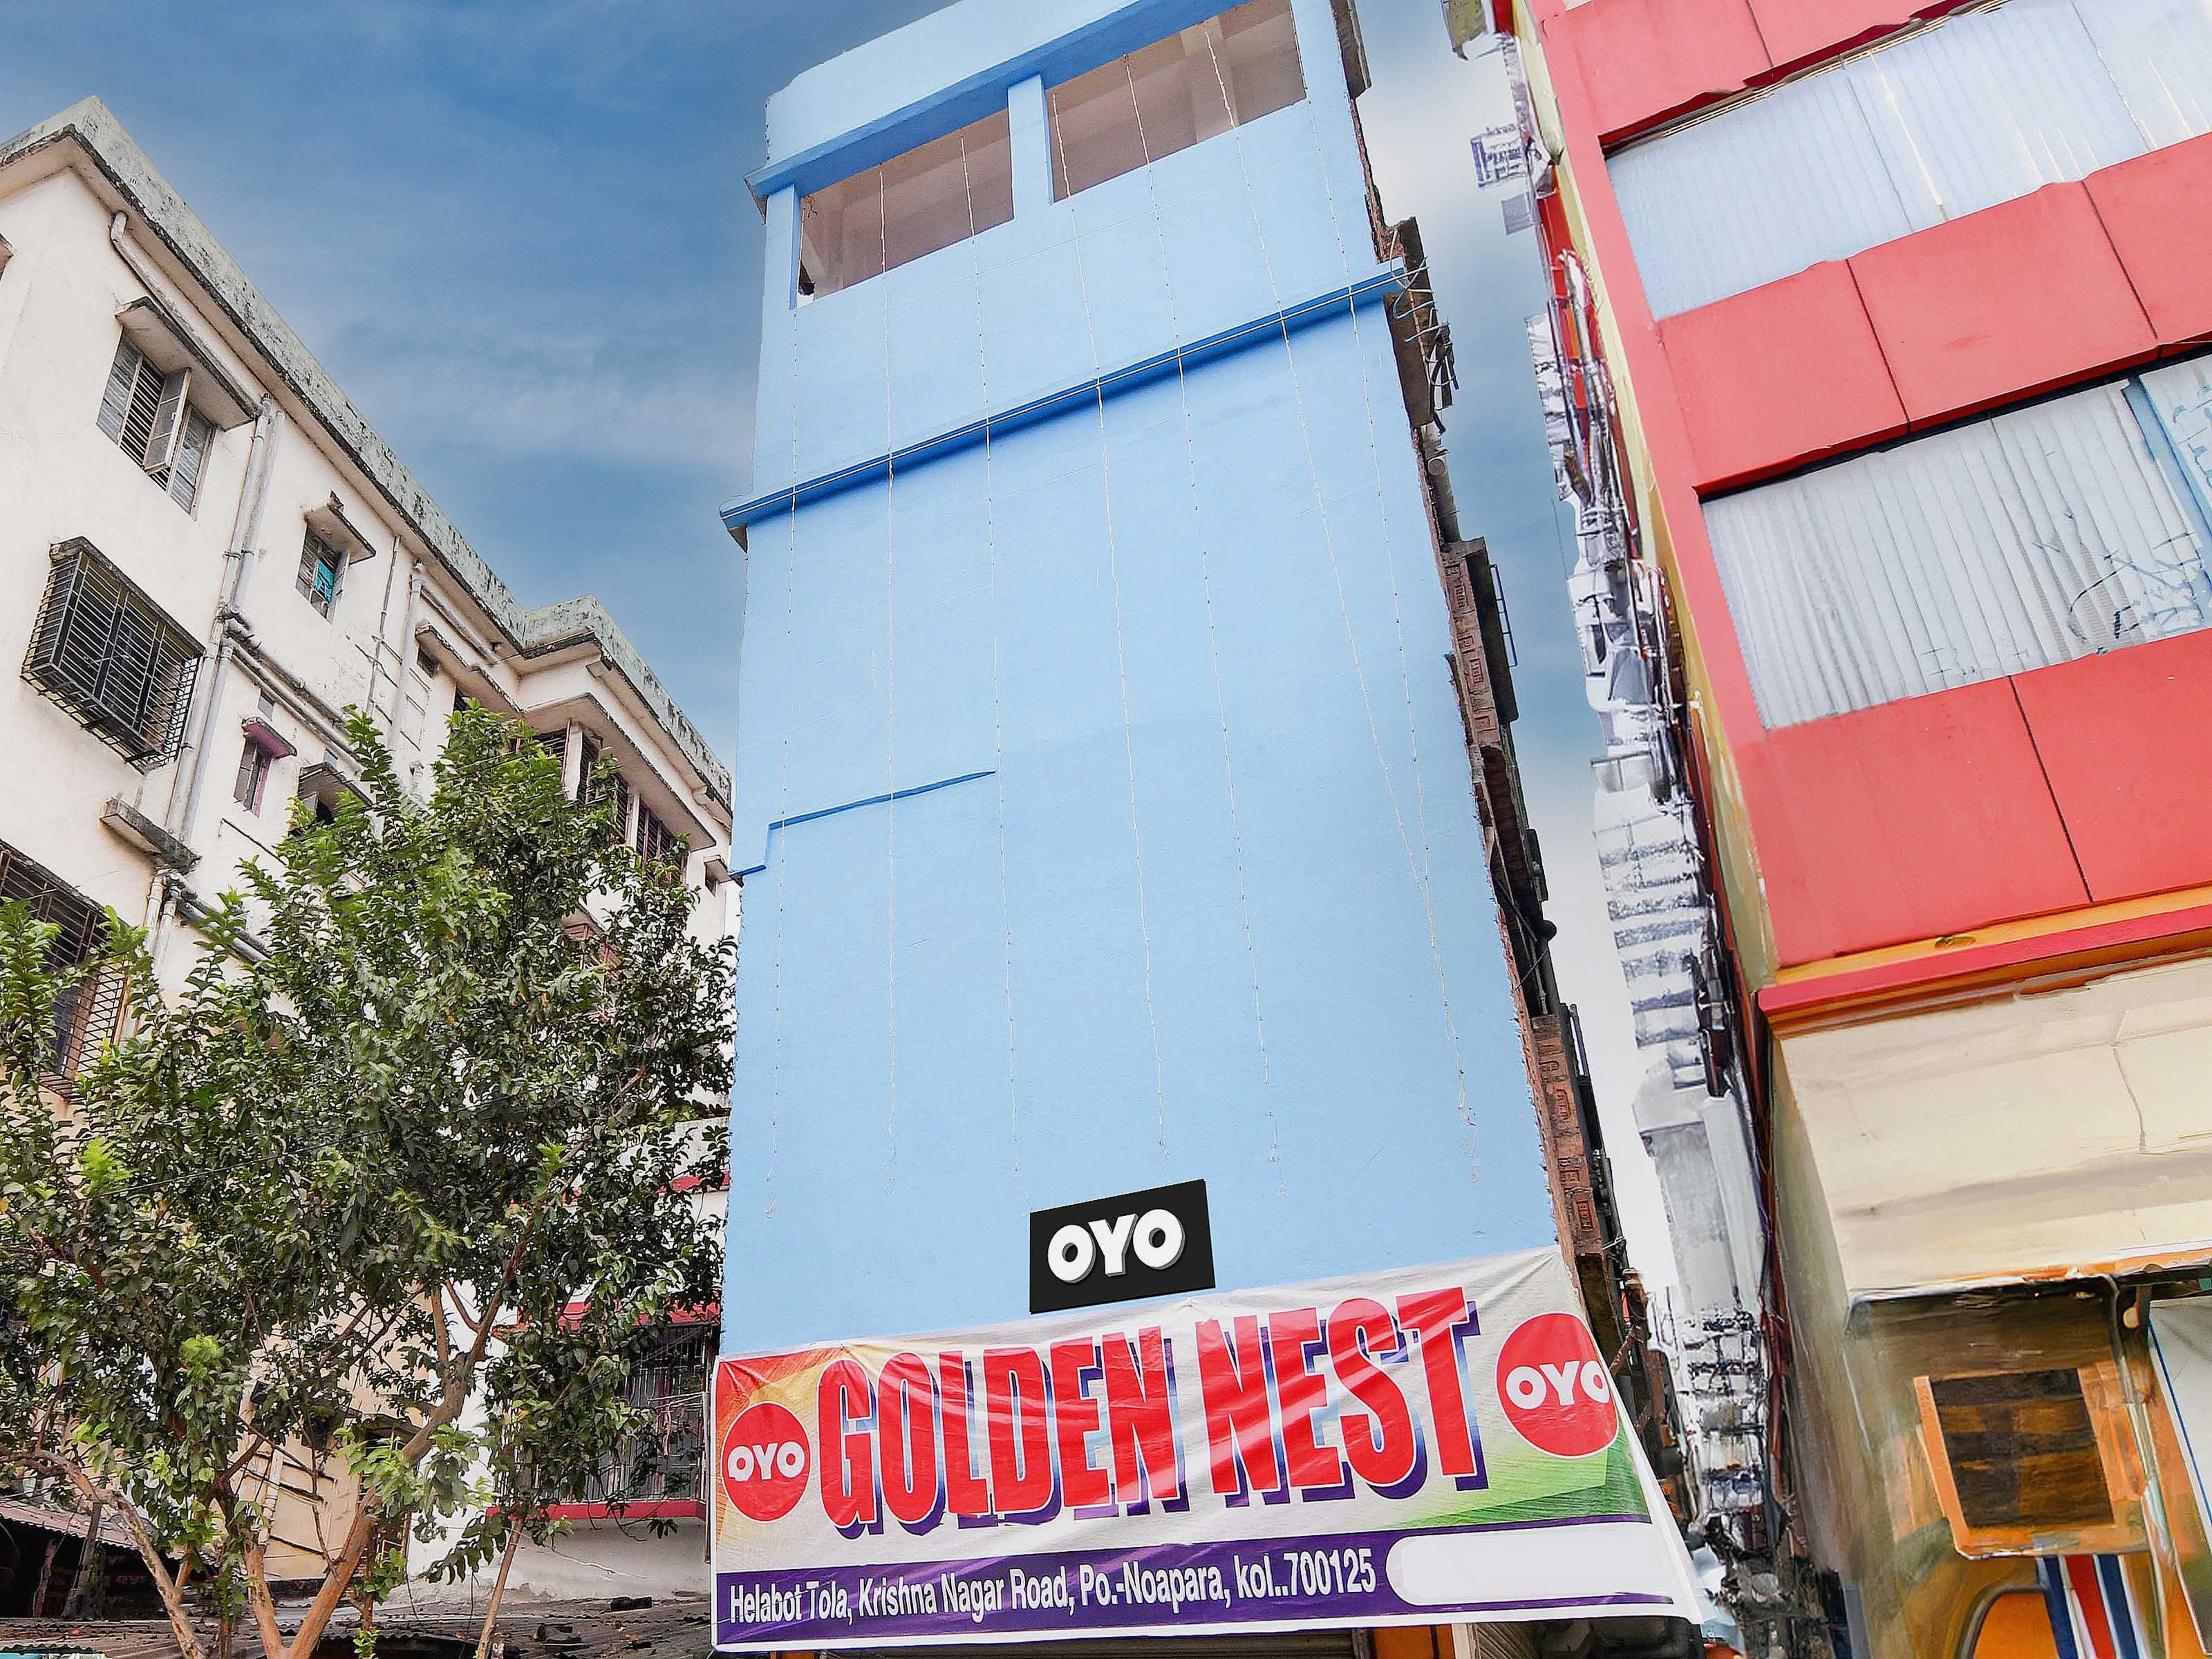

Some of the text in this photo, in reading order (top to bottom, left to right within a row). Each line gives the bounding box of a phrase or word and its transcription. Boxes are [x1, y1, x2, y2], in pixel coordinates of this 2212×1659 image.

[1047, 1208, 1185, 1284] OYO
[818, 1287, 1488, 1539] GOLDEN NEST
[1506, 1360, 1610, 1410] OYO
[727, 1441, 805, 1481] OYO
[729, 1582, 803, 1624] Helabot
[805, 1580, 853, 1626] Tola,
[859, 1576, 937, 1617] Krishna
[940, 1572, 1004, 1623] Nagar
[1009, 1565, 1075, 1616] Road,
